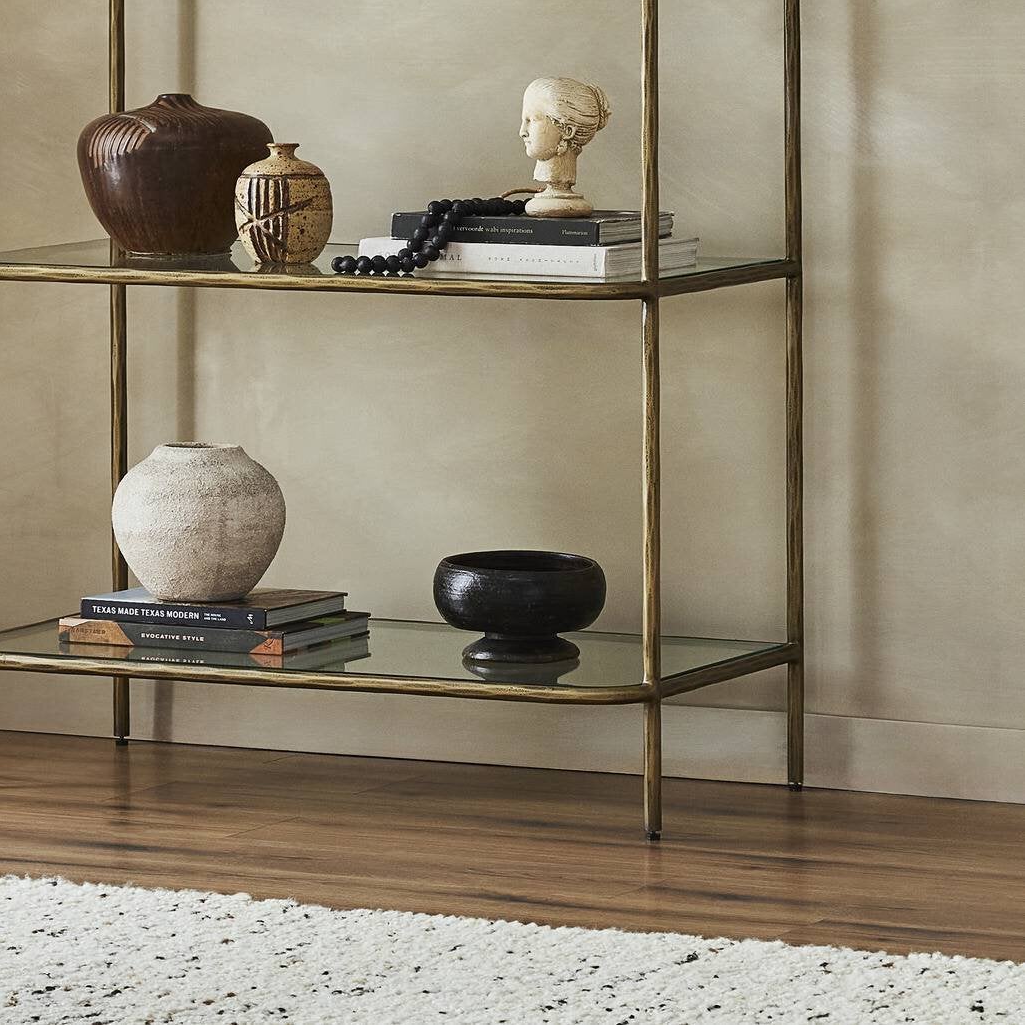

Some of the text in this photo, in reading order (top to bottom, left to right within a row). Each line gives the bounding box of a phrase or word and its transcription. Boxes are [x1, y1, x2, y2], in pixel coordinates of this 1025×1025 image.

[500, 226, 533, 234] inspirations
[92, 605, 200, 620] TEXAS MADE TEXAS MODERN
